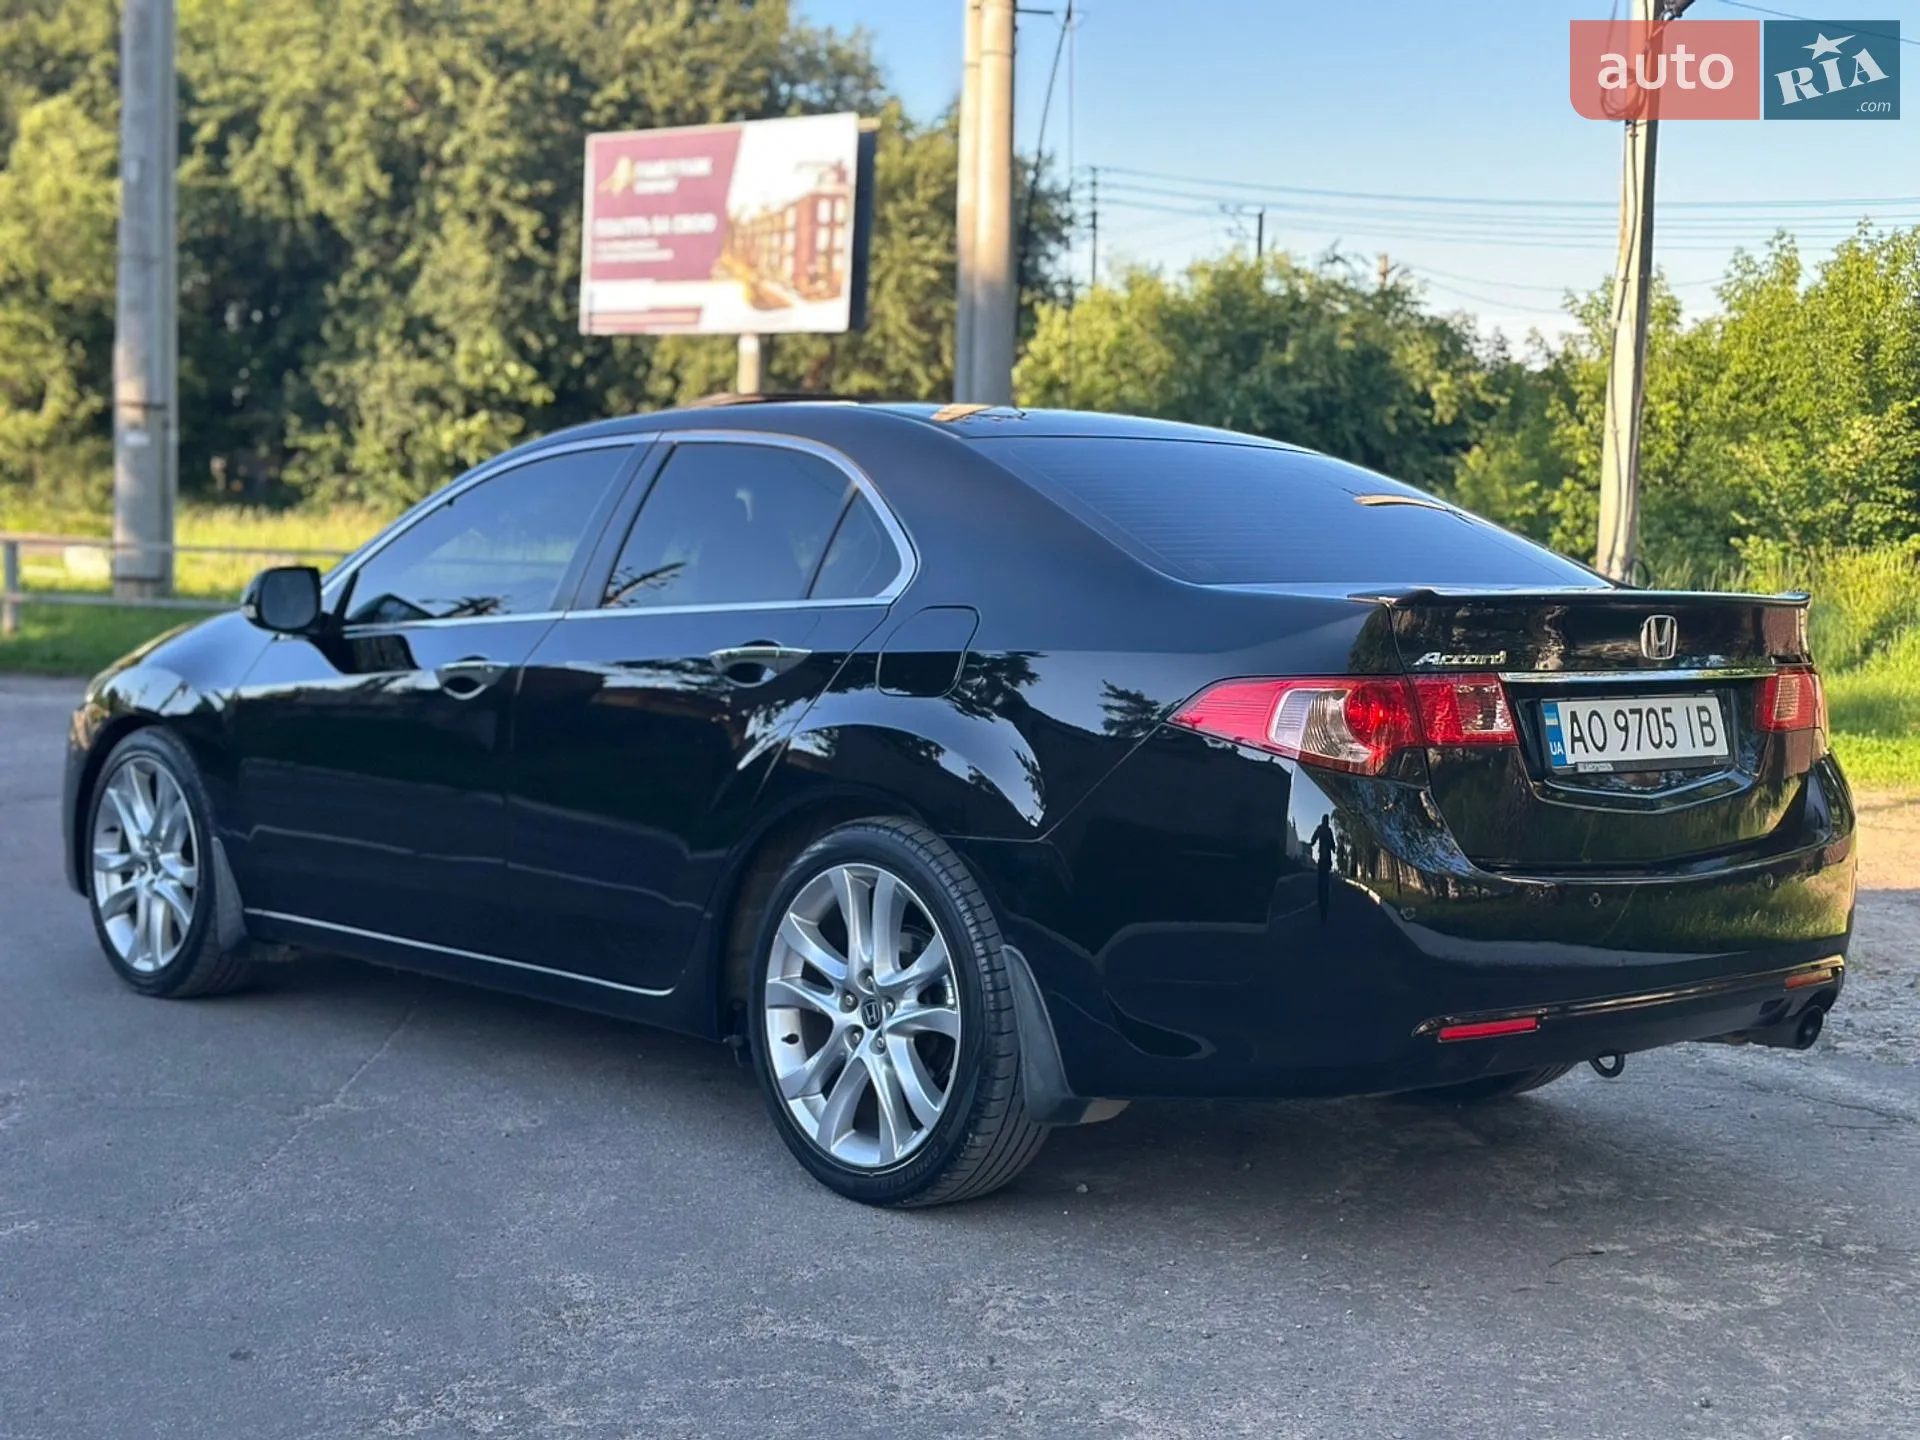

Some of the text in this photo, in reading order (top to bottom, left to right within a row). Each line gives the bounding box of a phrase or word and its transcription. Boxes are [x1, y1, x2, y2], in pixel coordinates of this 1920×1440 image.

[1412, 650, 1507, 665] Accord
[1569, 705, 1717, 754] AO 9705 IB
[1549, 741, 1564, 755] UA
